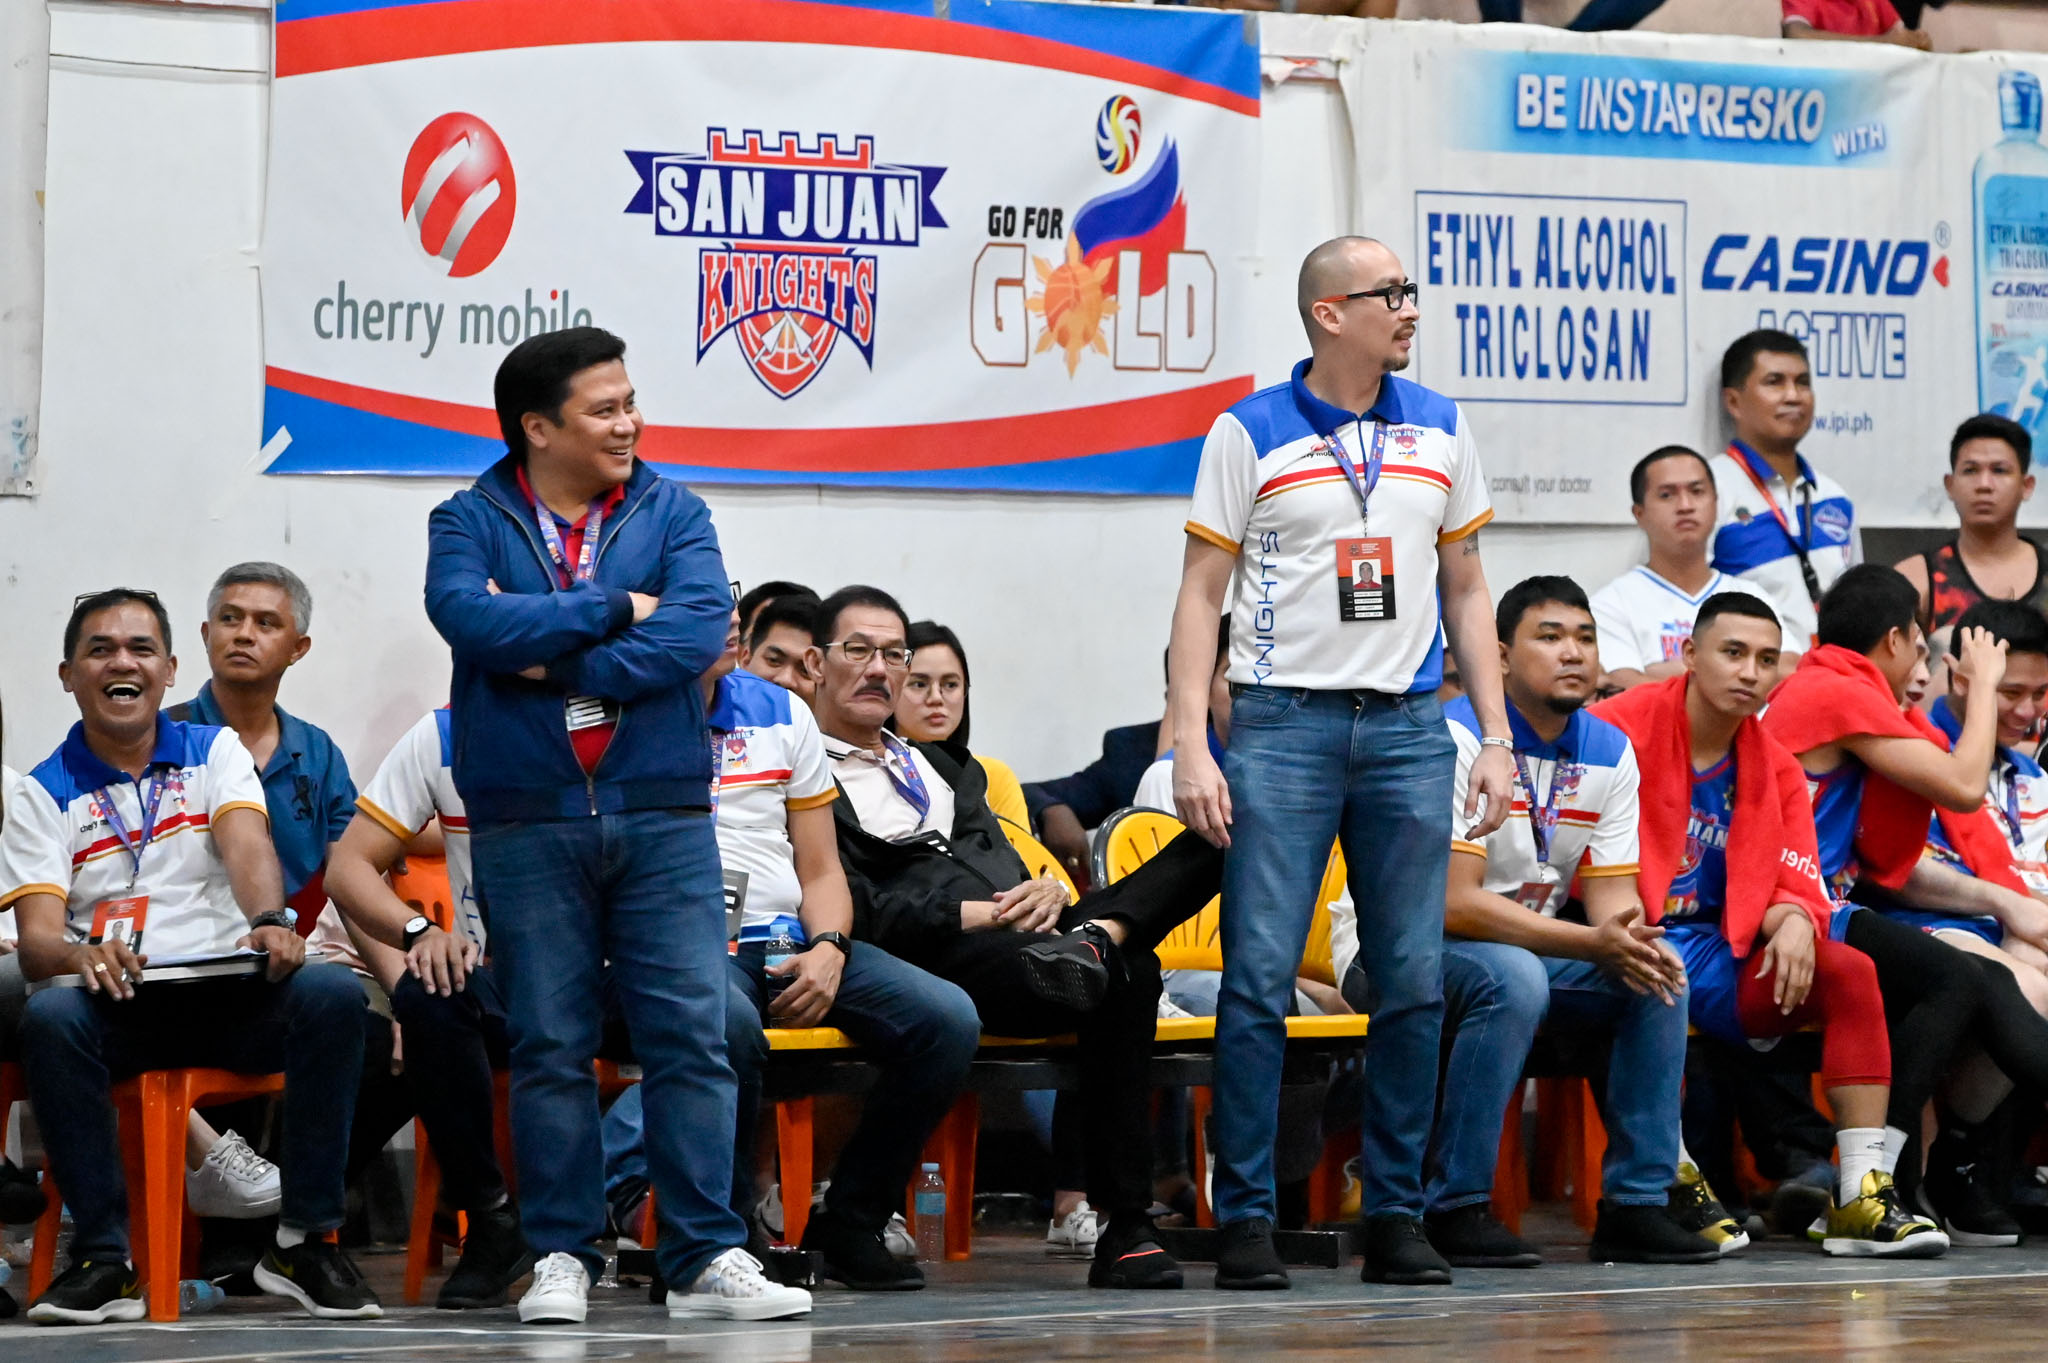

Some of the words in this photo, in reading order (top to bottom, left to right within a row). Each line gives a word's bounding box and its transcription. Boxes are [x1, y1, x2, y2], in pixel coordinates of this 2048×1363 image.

[1517, 73, 1568, 129] BE
[1578, 76, 1826, 143] INSTAPRESKO
[1832, 124, 1885, 157] WITH
[658, 165, 765, 235] SAN
[777, 173, 916, 242] JUAN
[988, 205, 1017, 237] GO
[1022, 206, 1063, 239] FOR
[1427, 212, 1522, 288] ETHYL
[1536, 216, 1677, 295] ALCOHOL
[1701, 233, 1930, 297] CASINO
[313, 279, 445, 359] cherry
[700, 251, 875, 350] KNIGHTS
[1455, 303, 1650, 382] TRICLOSAN
